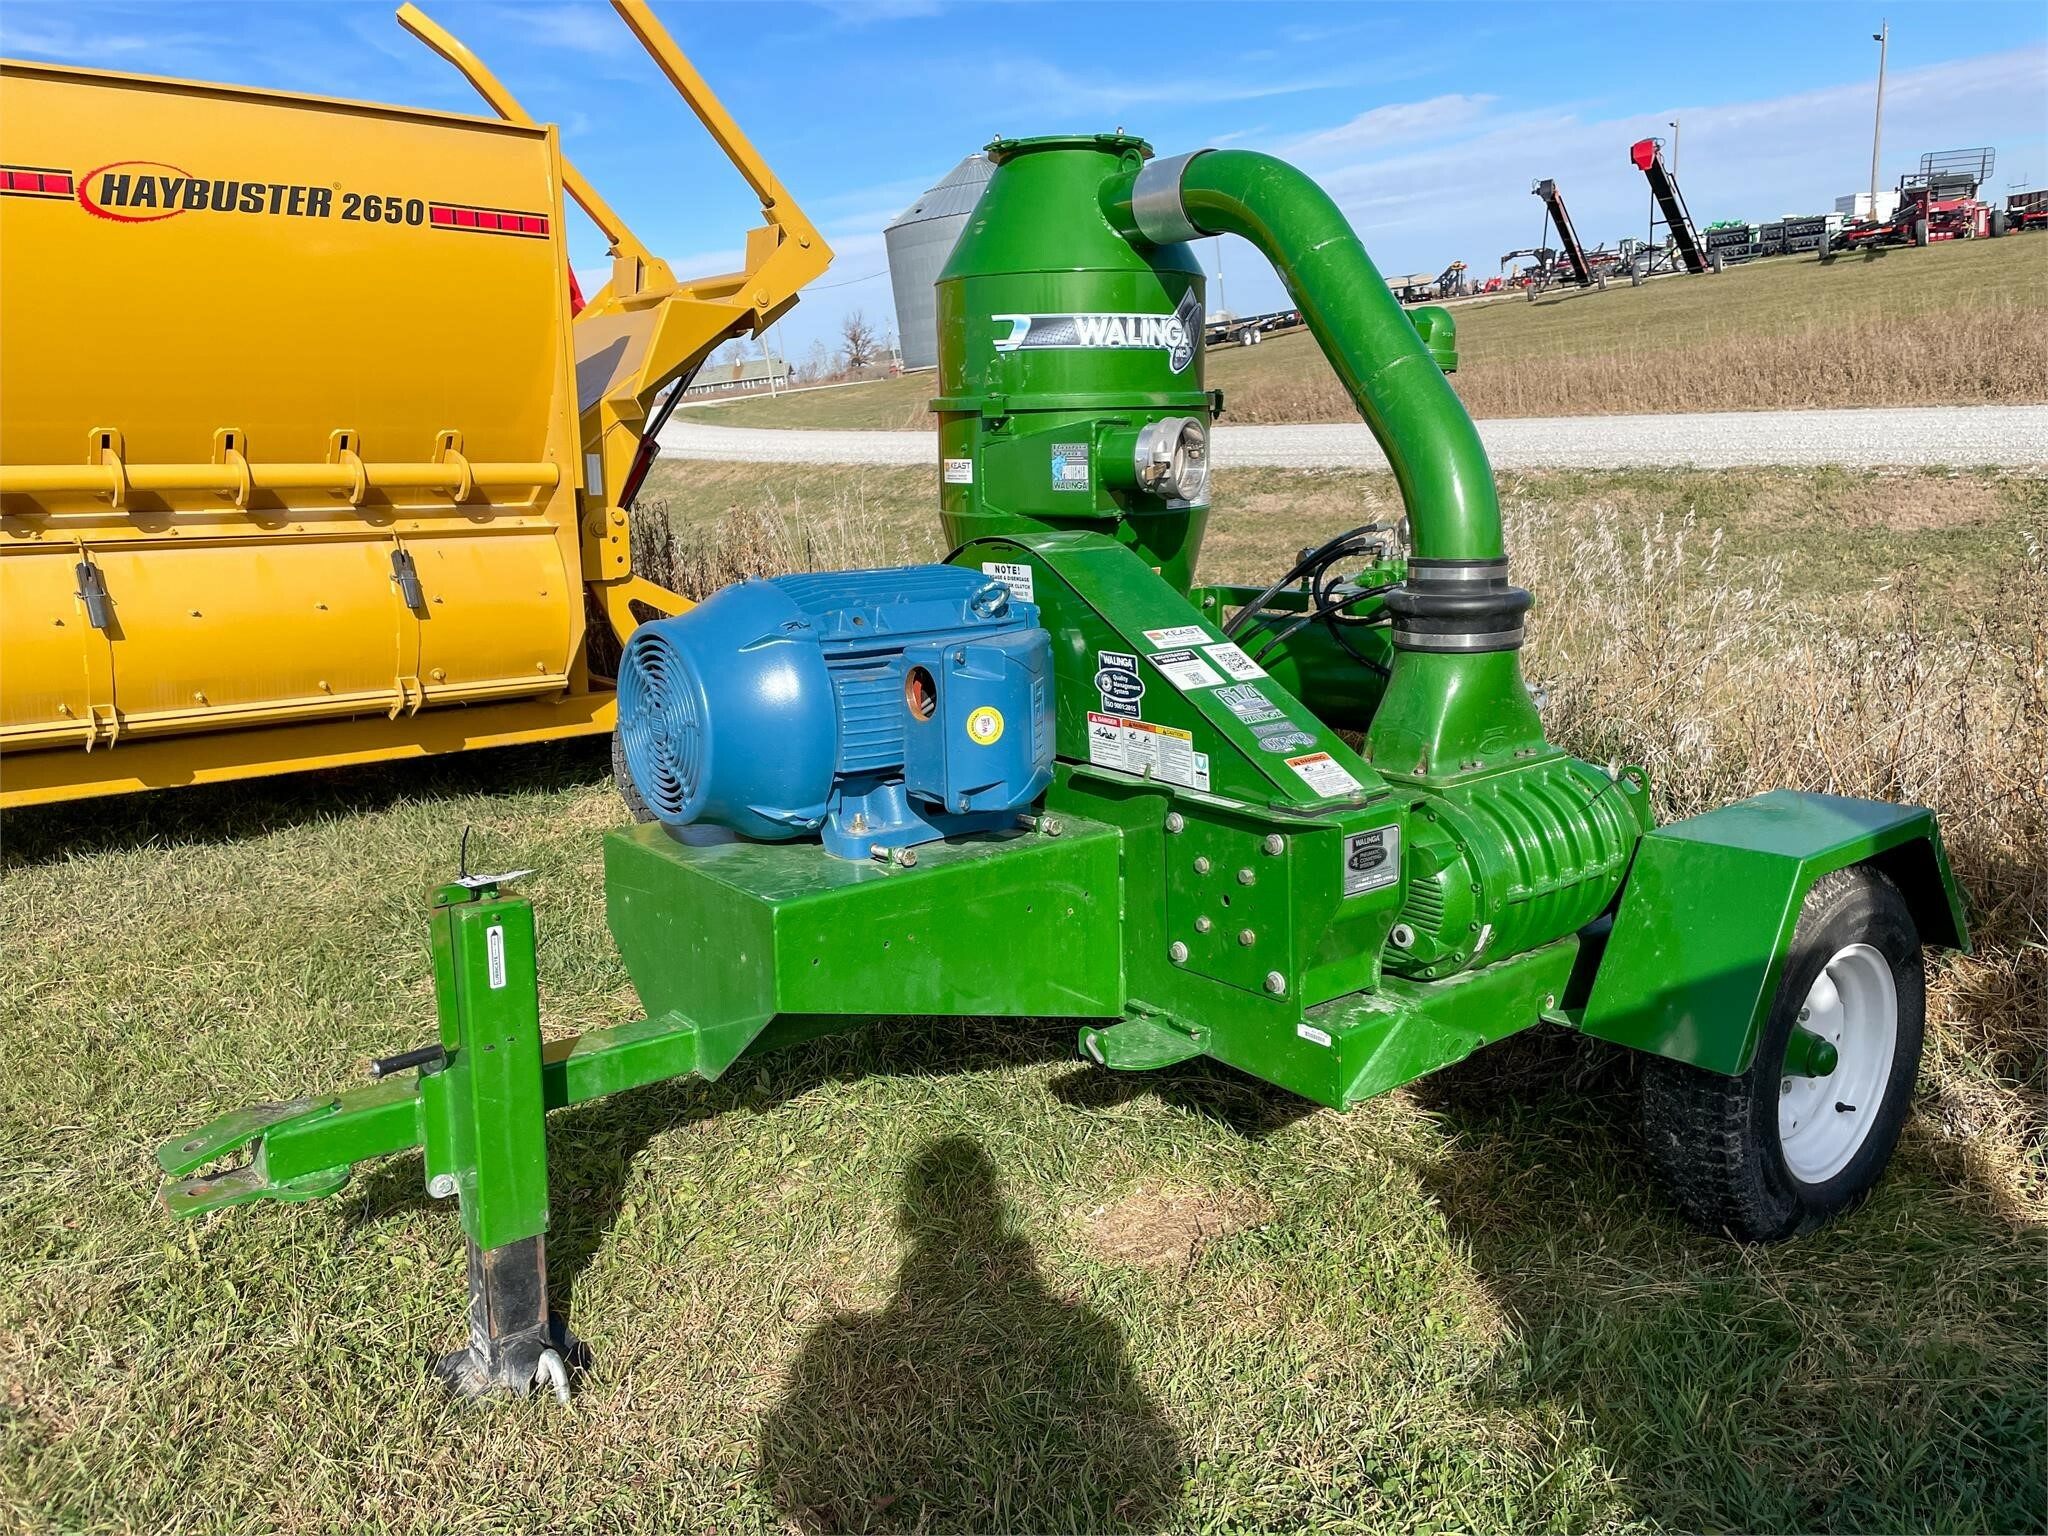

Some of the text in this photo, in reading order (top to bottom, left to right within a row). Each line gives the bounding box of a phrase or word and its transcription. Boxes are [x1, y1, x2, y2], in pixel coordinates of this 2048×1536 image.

[100, 174, 425, 226] HAYBUSTER 2650
[1074, 315, 1191, 347] WALINGA
[1054, 481, 1088, 490] WALINGA
[994, 564, 1021, 575] NOTE!
[1163, 627, 1200, 637] KEAST
[1102, 654, 1133, 668] WALINGA
[1216, 685, 1264, 707] 614
[1355, 834, 1381, 848] WALINGA
